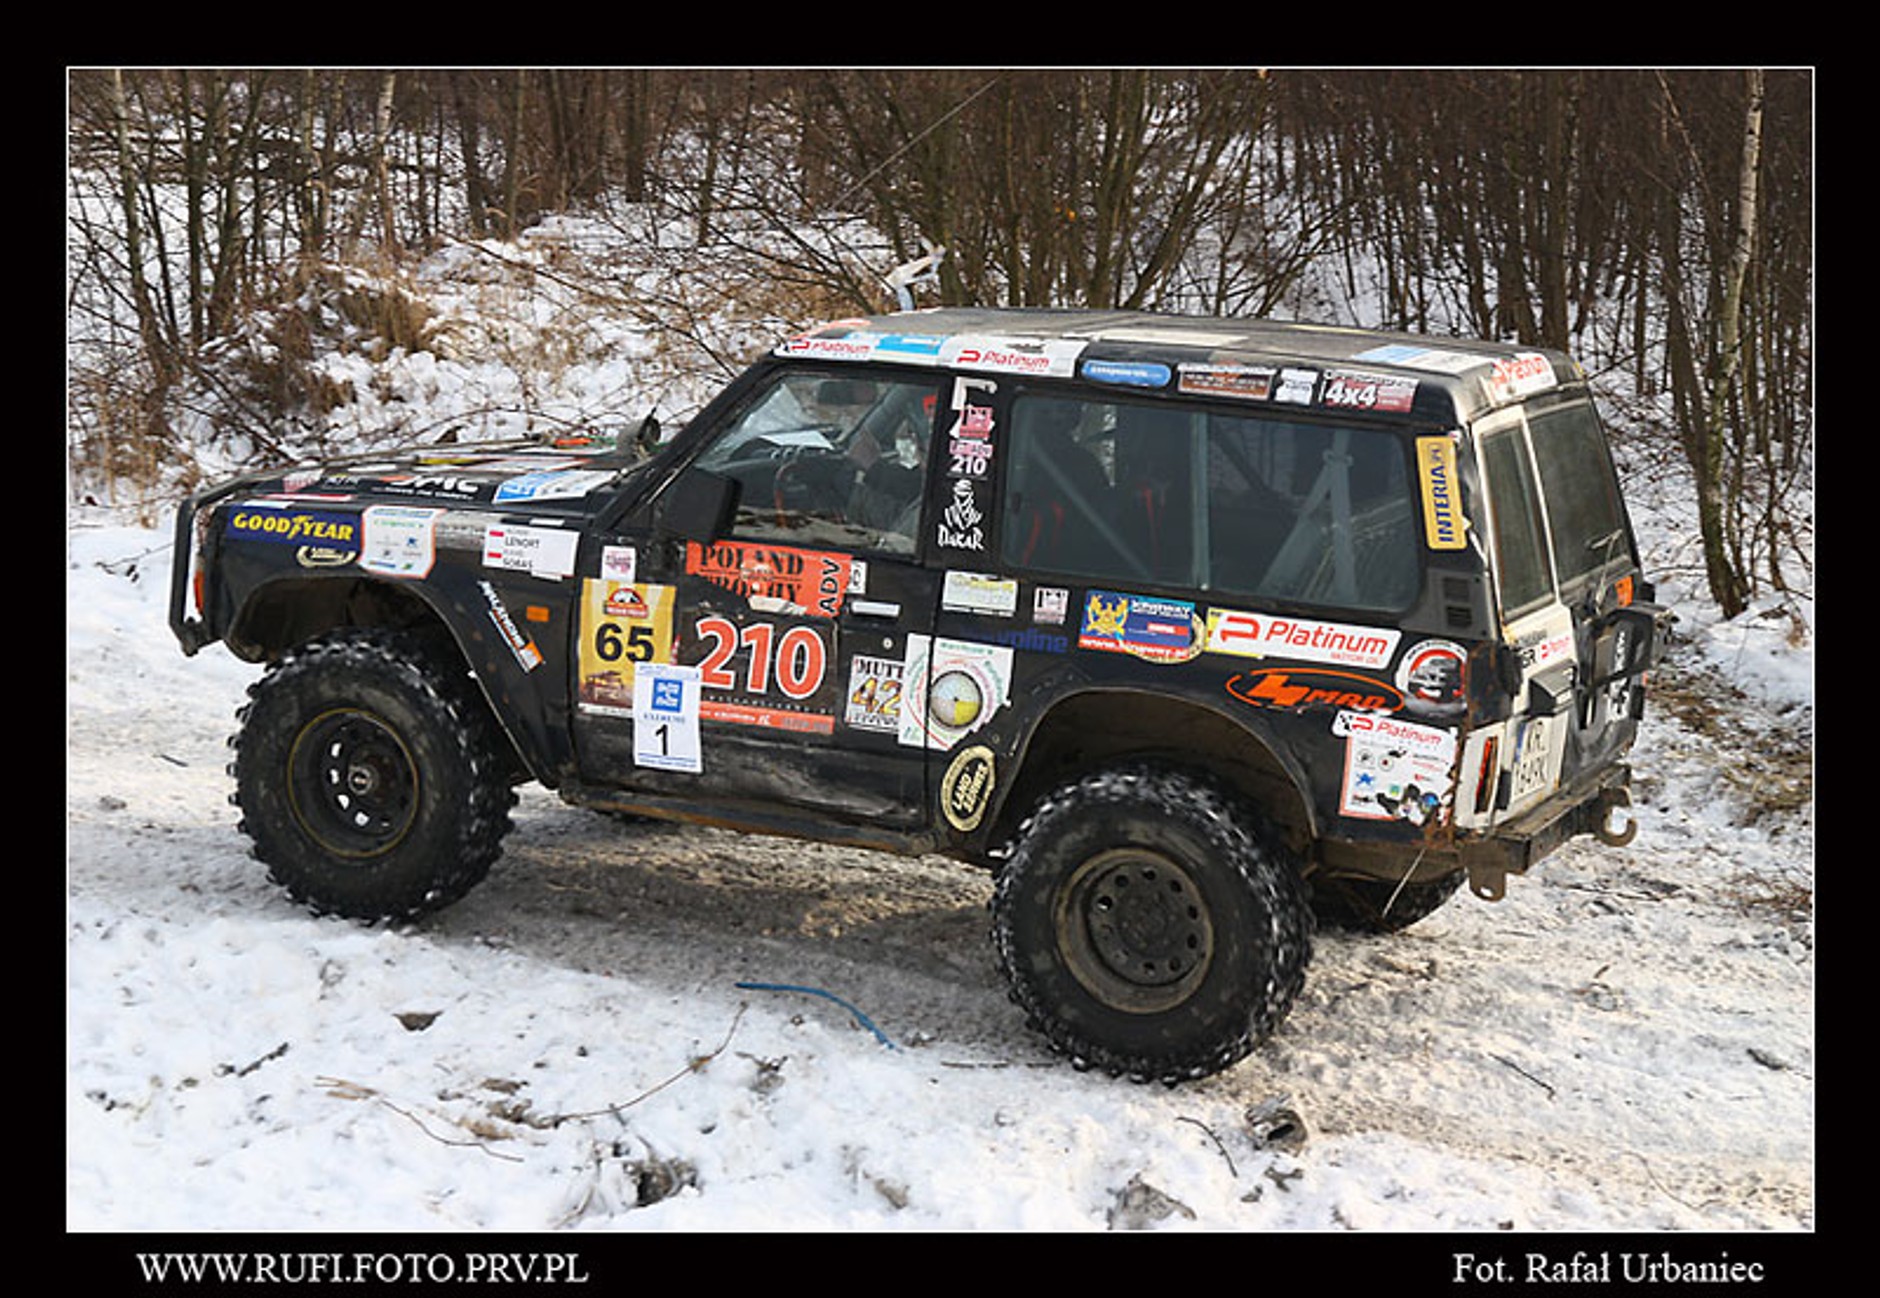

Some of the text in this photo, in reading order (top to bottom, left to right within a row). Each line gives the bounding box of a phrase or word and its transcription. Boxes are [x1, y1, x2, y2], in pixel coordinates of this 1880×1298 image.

[981, 349, 1050, 369] Platinum
[1325, 380, 1376, 408] 4x4
[951, 455, 987, 475] 210
[232, 511, 354, 542] GOODYEAR
[819, 558, 841, 613] ADV
[594, 622, 656, 663] 65
[1264, 620, 1389, 656] Platinum
[696, 617, 826, 699] 210
[851, 676, 903, 718] 42
[655, 723, 669, 757] 1
[1376, 720, 1442, 745] Platinum
